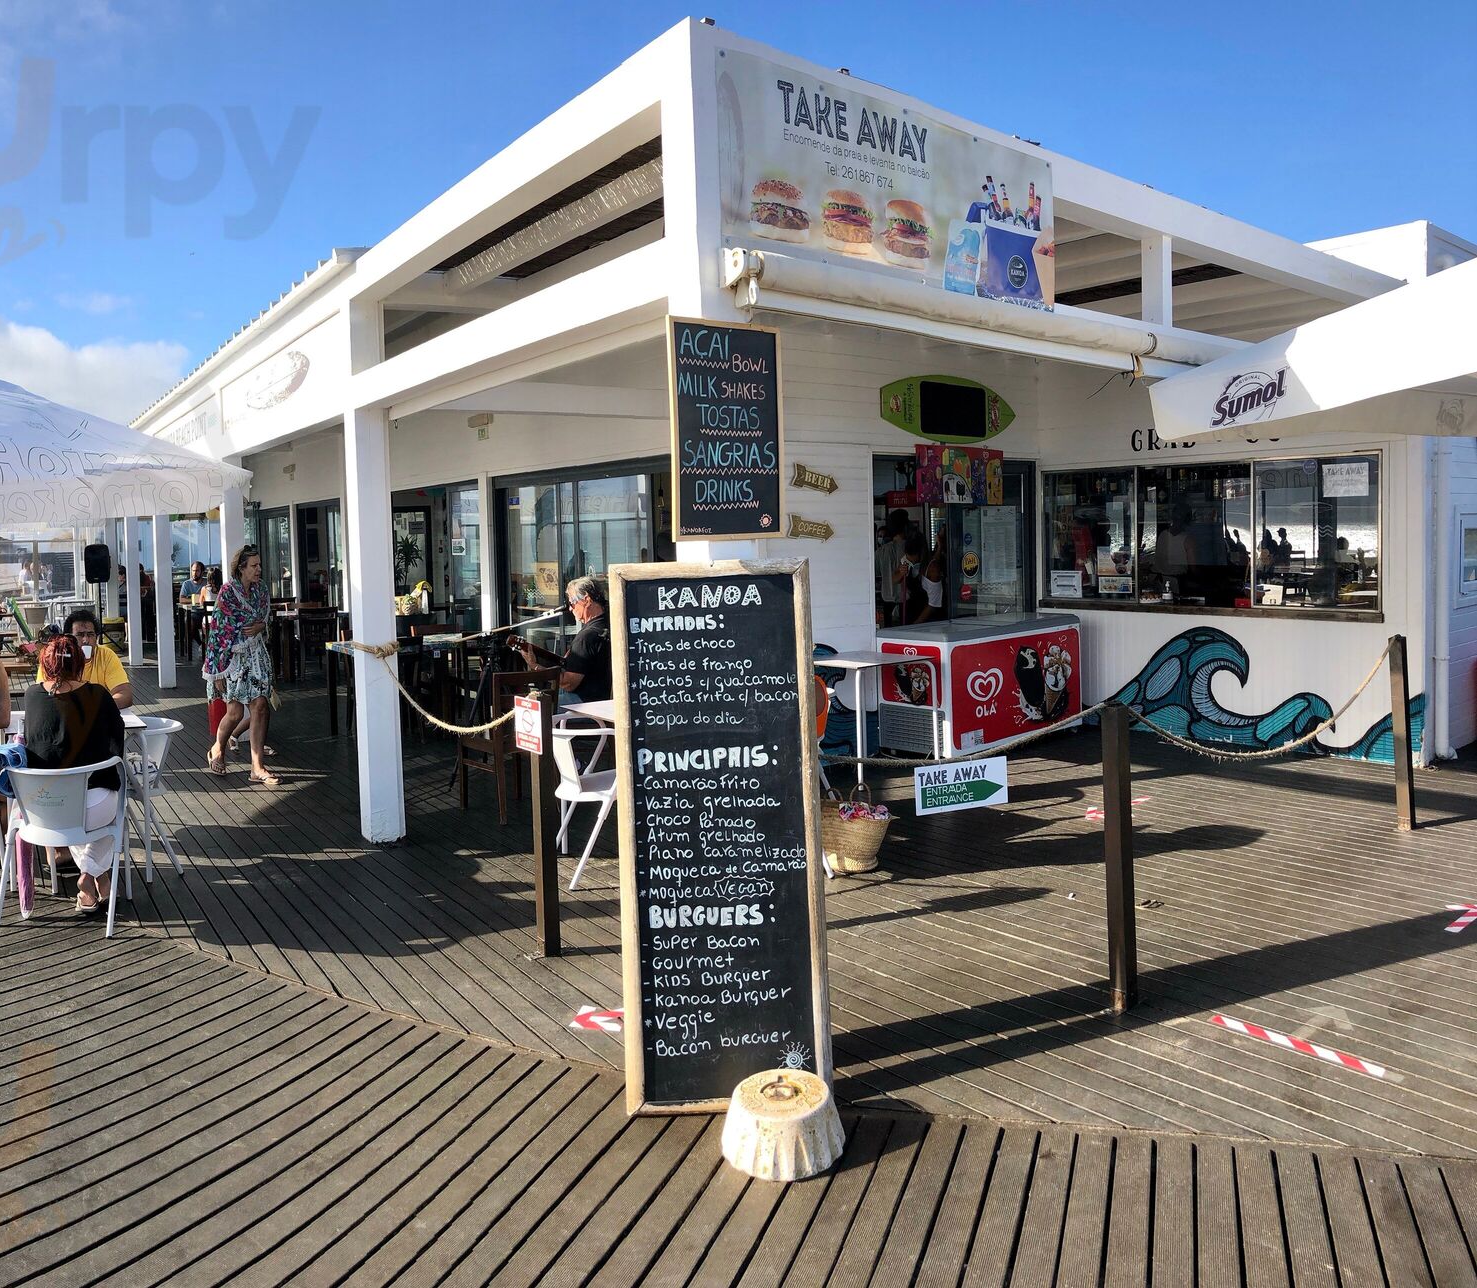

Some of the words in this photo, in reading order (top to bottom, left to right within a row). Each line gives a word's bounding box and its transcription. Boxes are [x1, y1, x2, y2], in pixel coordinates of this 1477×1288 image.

[777, 79, 850, 142] TAKE
[856, 107, 928, 164] AWAY
[783, 128, 831, 153] Encomende
[833, 143, 843, 157] da
[843, 147, 862, 162] praia
[863, 153, 868, 163] e
[869, 153, 896, 171] levanta
[896, 163, 906, 173] no
[825, 161, 840, 177] Tel:
[678, 371, 719, 399] MILK
[720, 381, 766, 401] SHAKES
[1234, 374, 1262, 388] ORIGINAL
[1211, 367, 1287, 427] Sumol
[695, 403, 761, 430] TOSTAS
[682, 439, 776, 470] SANGRIAS
[805, 471, 831, 489] BEER
[695, 479, 754, 503] DRINKS
[798, 521, 827, 536] COFFEE
[657, 584, 762, 611] KANOA
[629, 614, 725, 634] ENTRADAS:
[676, 639, 691, 651] de
[679, 658, 696, 671] de
[639, 674, 693, 688] Nachos
[699, 677, 710, 691] c/
[714, 672, 797, 692] guacamole
[639, 690, 695, 706] Batata
[739, 689, 750, 707] c/
[755, 689, 799, 702] bacon
[975, 700, 997, 718] OLÁ
[645, 710, 688, 731] Sopa
[693, 712, 710, 725] do
[715, 712, 745, 725] dia
[637, 744, 779, 775] PRINCIPAIS:
[918, 767, 948, 787] TAKE
[953, 764, 987, 783] AWAY
[644, 793, 695, 811] Vazia
[703, 794, 781, 818] grelhada
[646, 814, 691, 828] Choco
[699, 811, 757, 829] Panado
[647, 828, 690, 843] Atum
[699, 829, 766, 849] grelhado
[649, 847, 694, 861] Piano
[703, 843, 806, 860] caramelizado
[650, 864, 722, 887] Moqueca
[725, 864, 738, 874] de
[707, 935, 761, 949] Bacon
[652, 952, 735, 969] Gourmet
[720, 986, 792, 1006] Burguer
[655, 1010, 716, 1040] Veggie
[655, 1039, 712, 1057] Bacon
